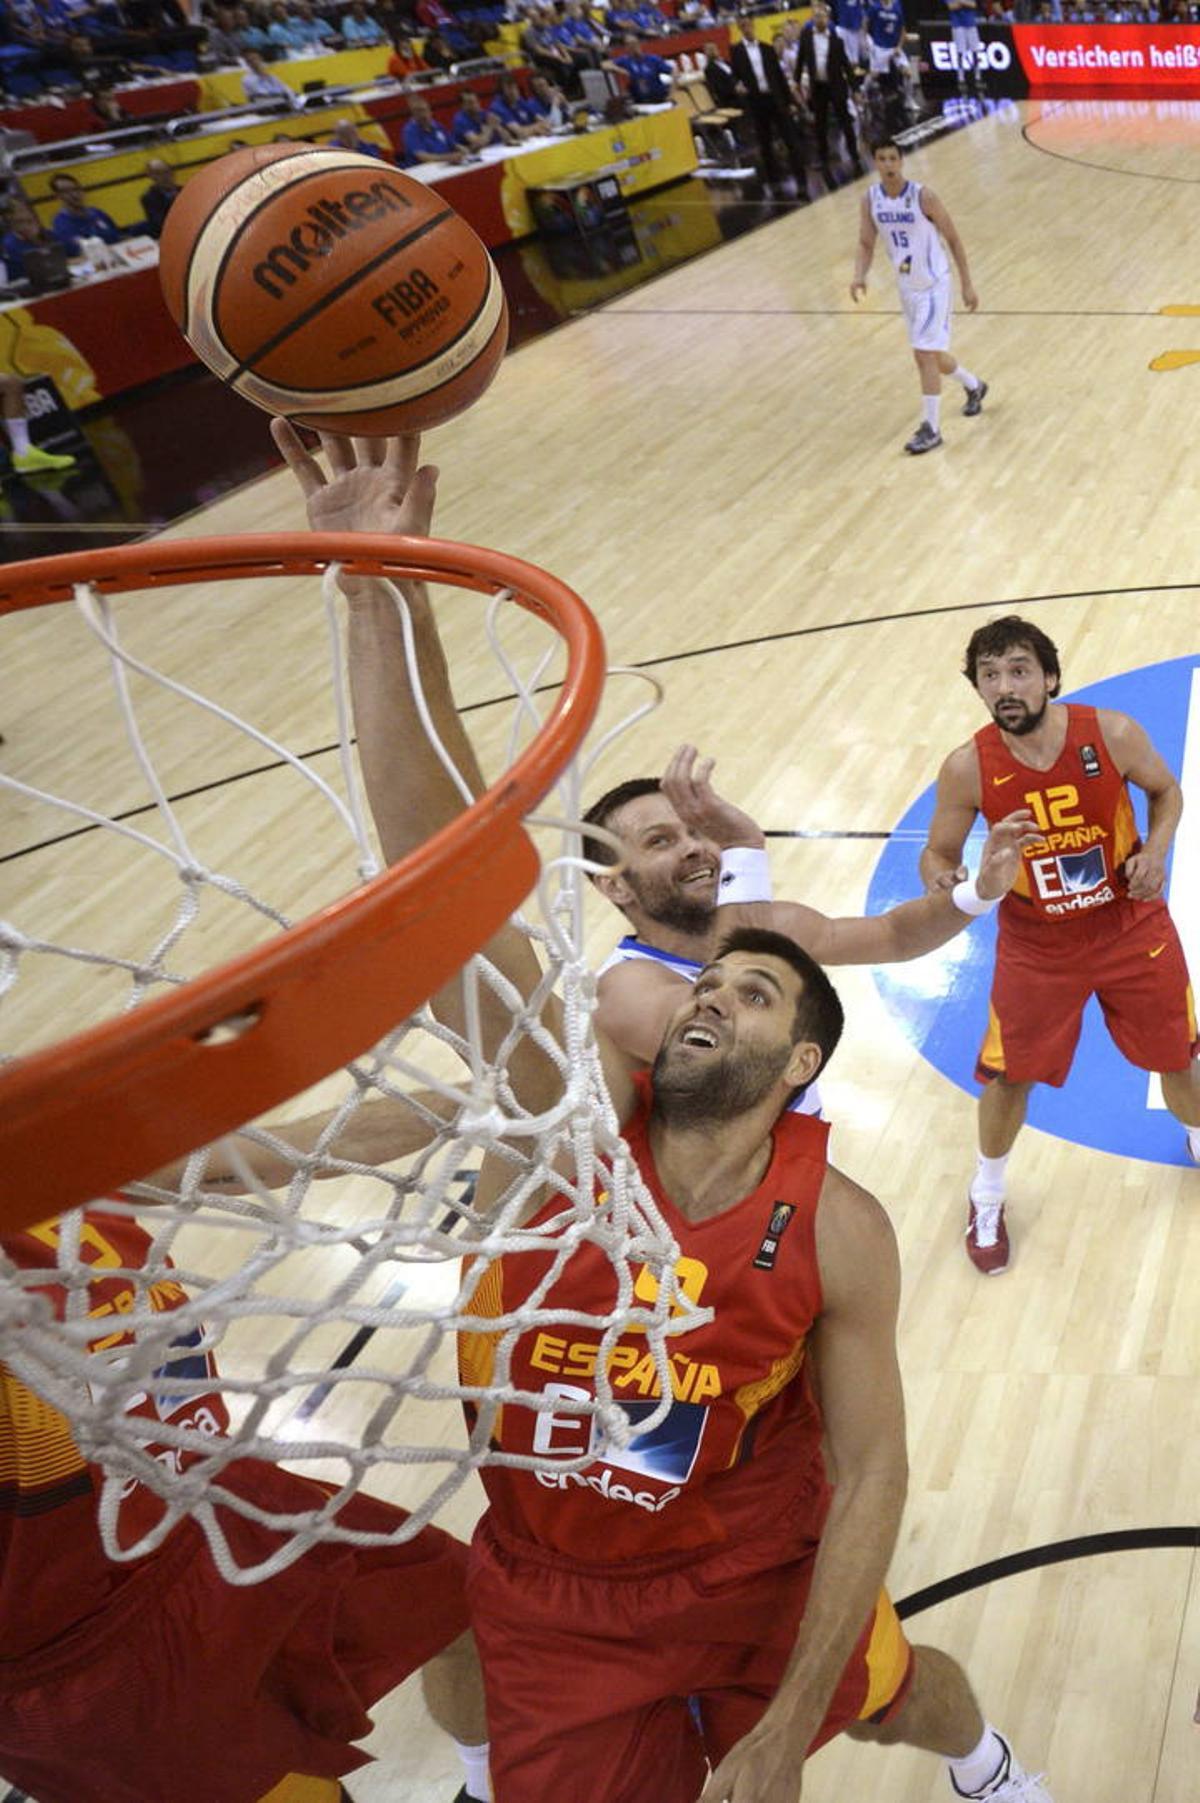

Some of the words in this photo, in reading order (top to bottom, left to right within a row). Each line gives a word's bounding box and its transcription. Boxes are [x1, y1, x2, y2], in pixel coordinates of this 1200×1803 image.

[1030, 44, 1144, 67] Versichern
[1150, 44, 1200, 68] heiß
[877, 211, 915, 224] ICELAND
[252, 178, 412, 300] molten
[891, 230, 909, 248] 15
[371, 268, 440, 327] FIBA
[1024, 784, 1084, 831] 12
[1045, 886, 1115, 915] endesa
[529, 1332, 723, 1405] ESPAÑA
